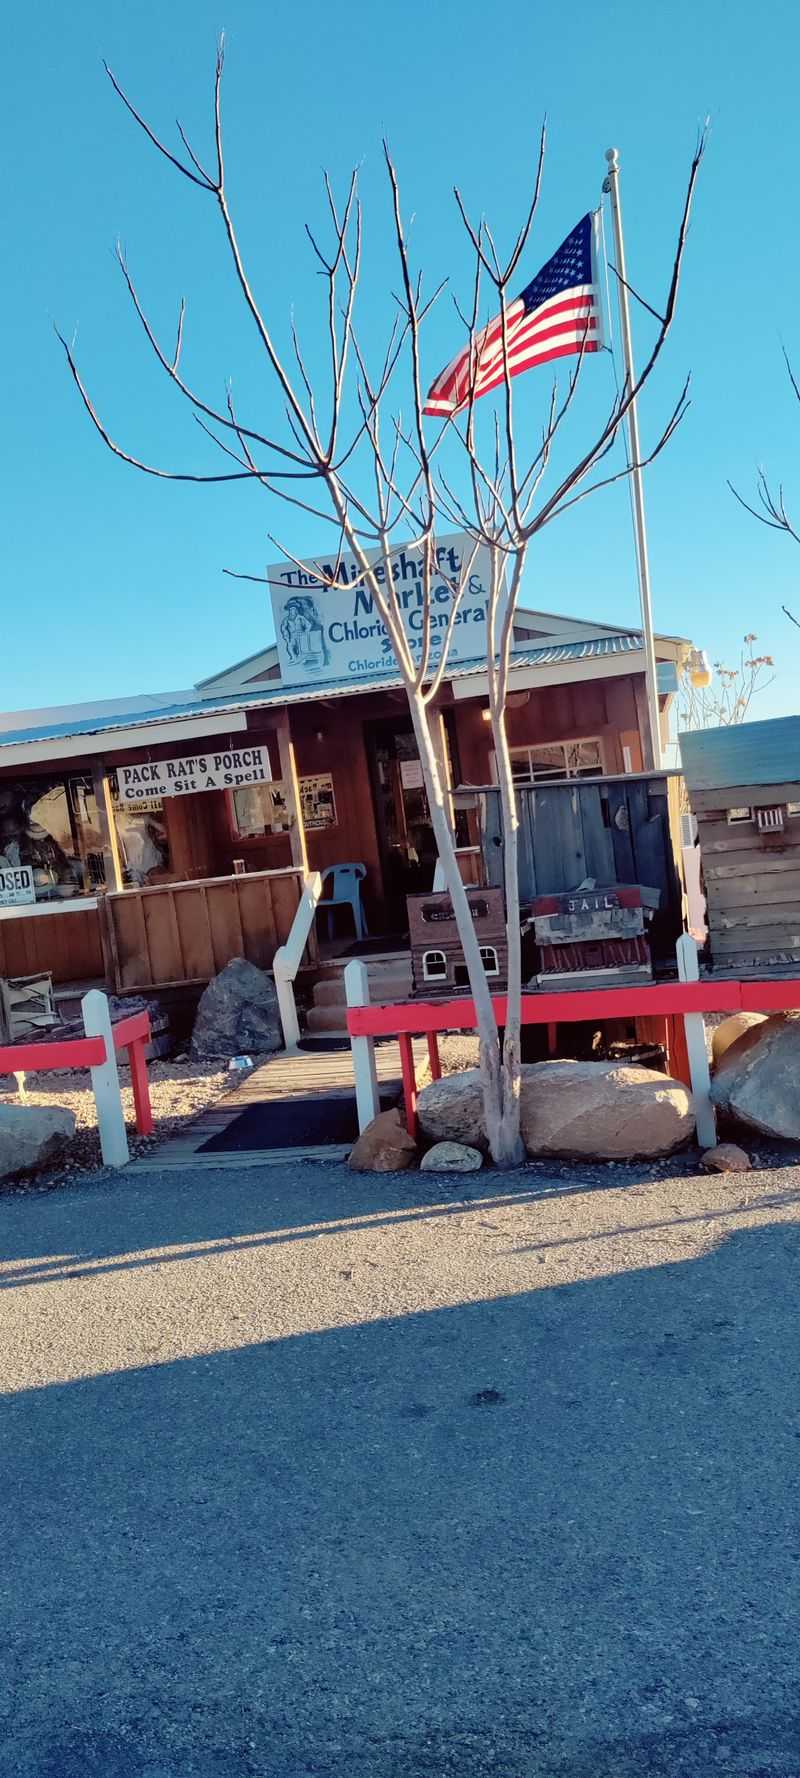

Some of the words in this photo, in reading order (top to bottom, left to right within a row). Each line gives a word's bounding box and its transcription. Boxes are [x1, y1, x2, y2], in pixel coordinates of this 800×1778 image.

[280, 569, 318, 586] The
[469, 575, 486, 595] &
[123, 764, 162, 786] PACK
[166, 757, 208, 779] RAT'S
[214, 749, 263, 771] PORCH
[125, 784, 167, 799] Come
[173, 777, 197, 792] Sit
[205, 776, 217, 788] A
[223, 769, 266, 786] Spell
[568, 896, 613, 911] JAIL
